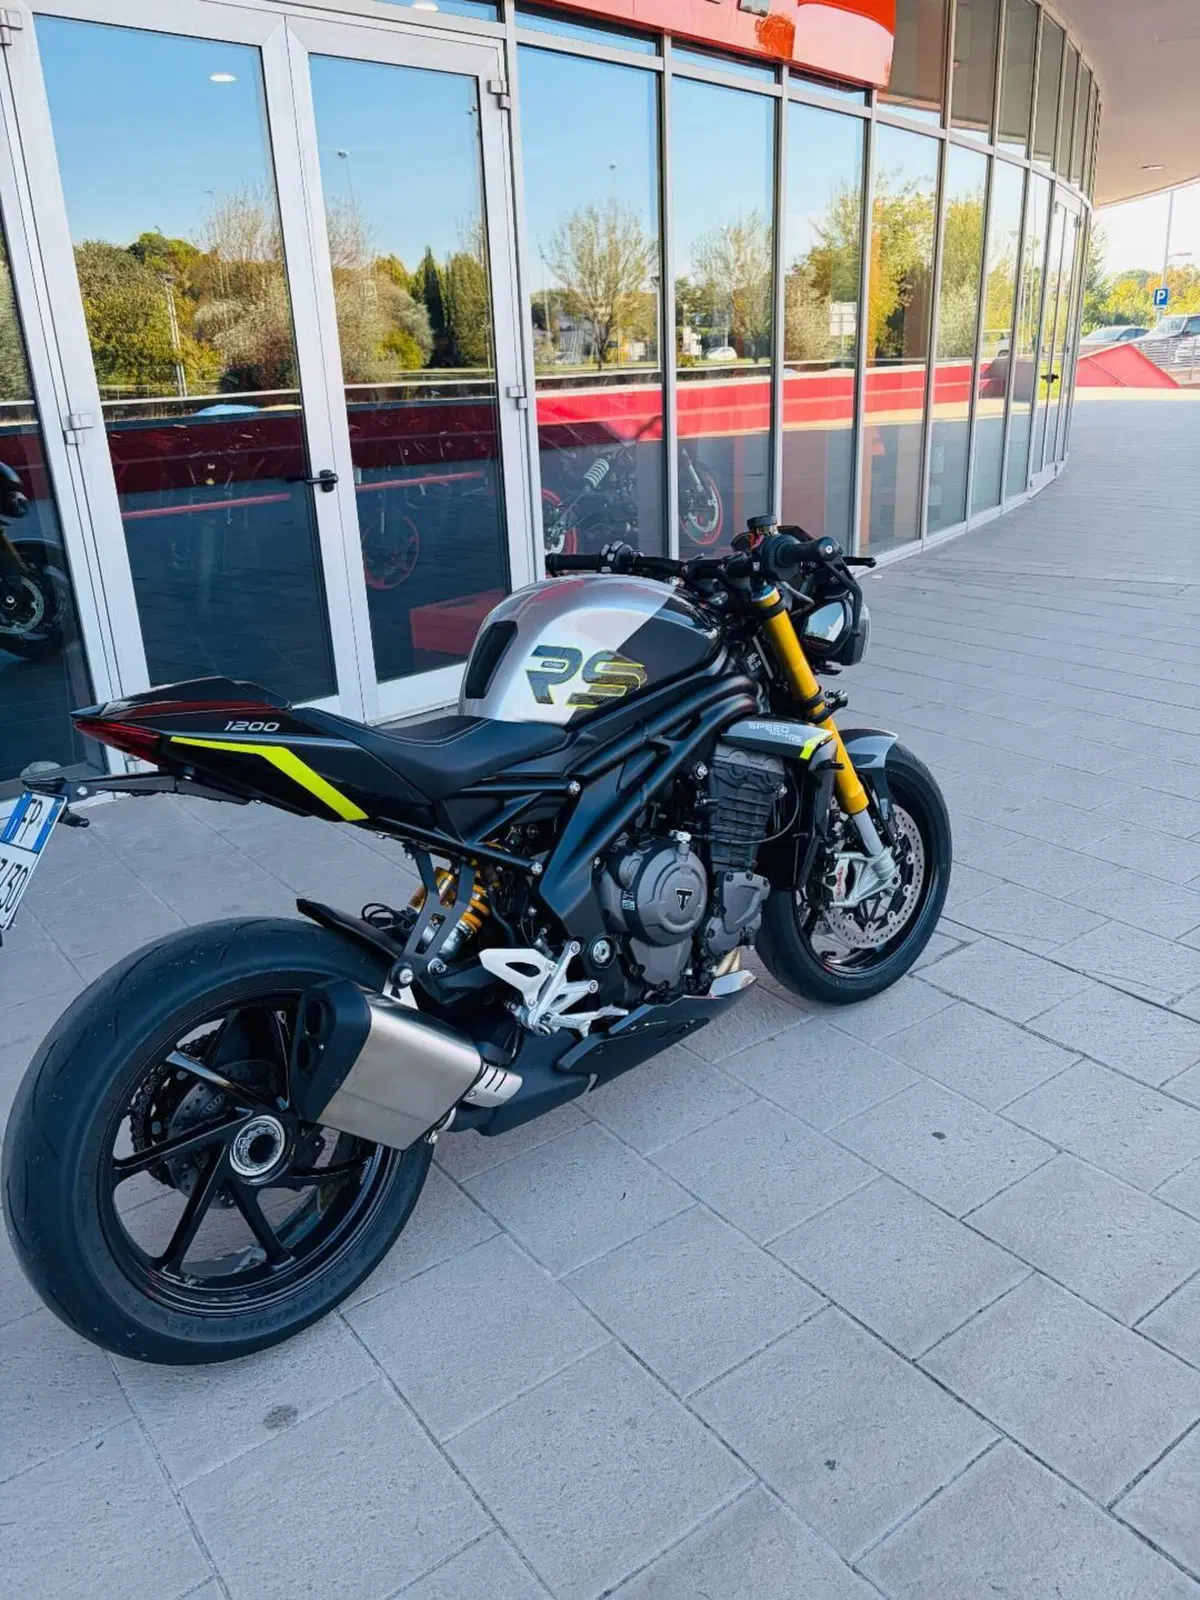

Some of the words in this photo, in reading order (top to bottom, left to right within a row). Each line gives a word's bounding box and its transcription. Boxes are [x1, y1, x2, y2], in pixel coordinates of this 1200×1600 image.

[1156, 289, 1166, 304] P
[526, 645, 648, 709] RS
[224, 721, 280, 732] 1200
[747, 721, 789, 733] SPEED
